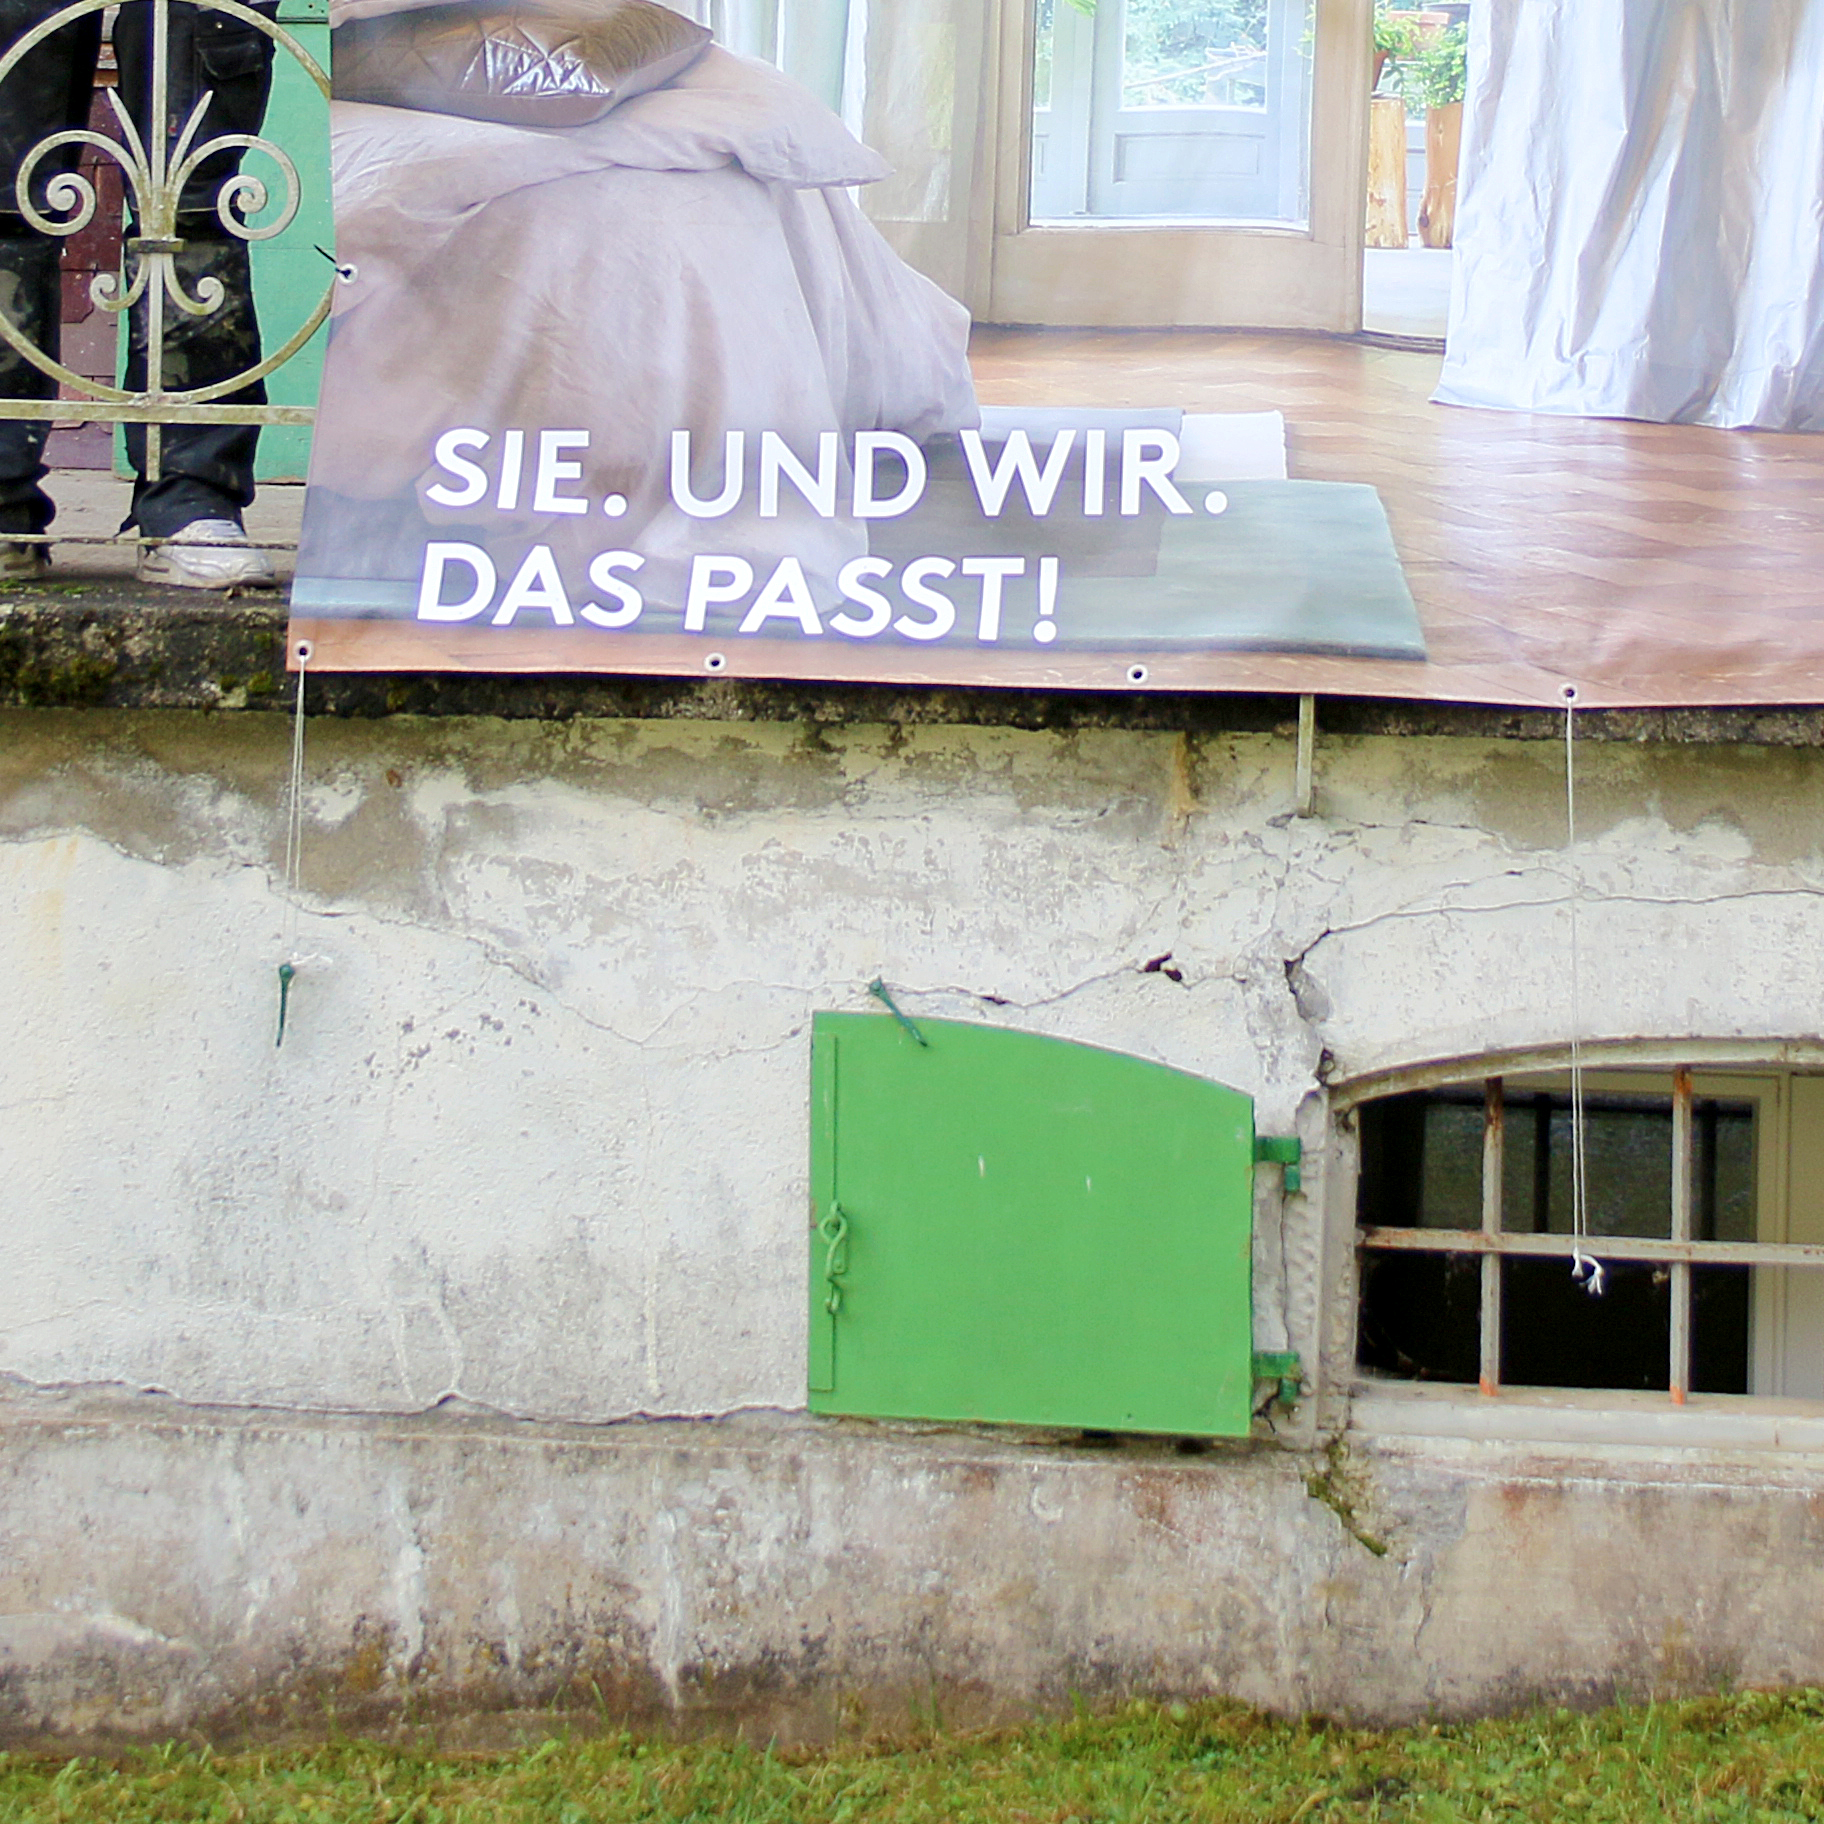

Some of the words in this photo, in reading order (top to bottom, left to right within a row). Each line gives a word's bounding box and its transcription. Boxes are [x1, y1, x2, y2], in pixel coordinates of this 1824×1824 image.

[426, 428, 629, 519] SIE.
[669, 428, 927, 521] UND
[958, 428, 1228, 518] WIR.
[416, 542, 645, 629] DAS
[683, 554, 1060, 645] PASST!
